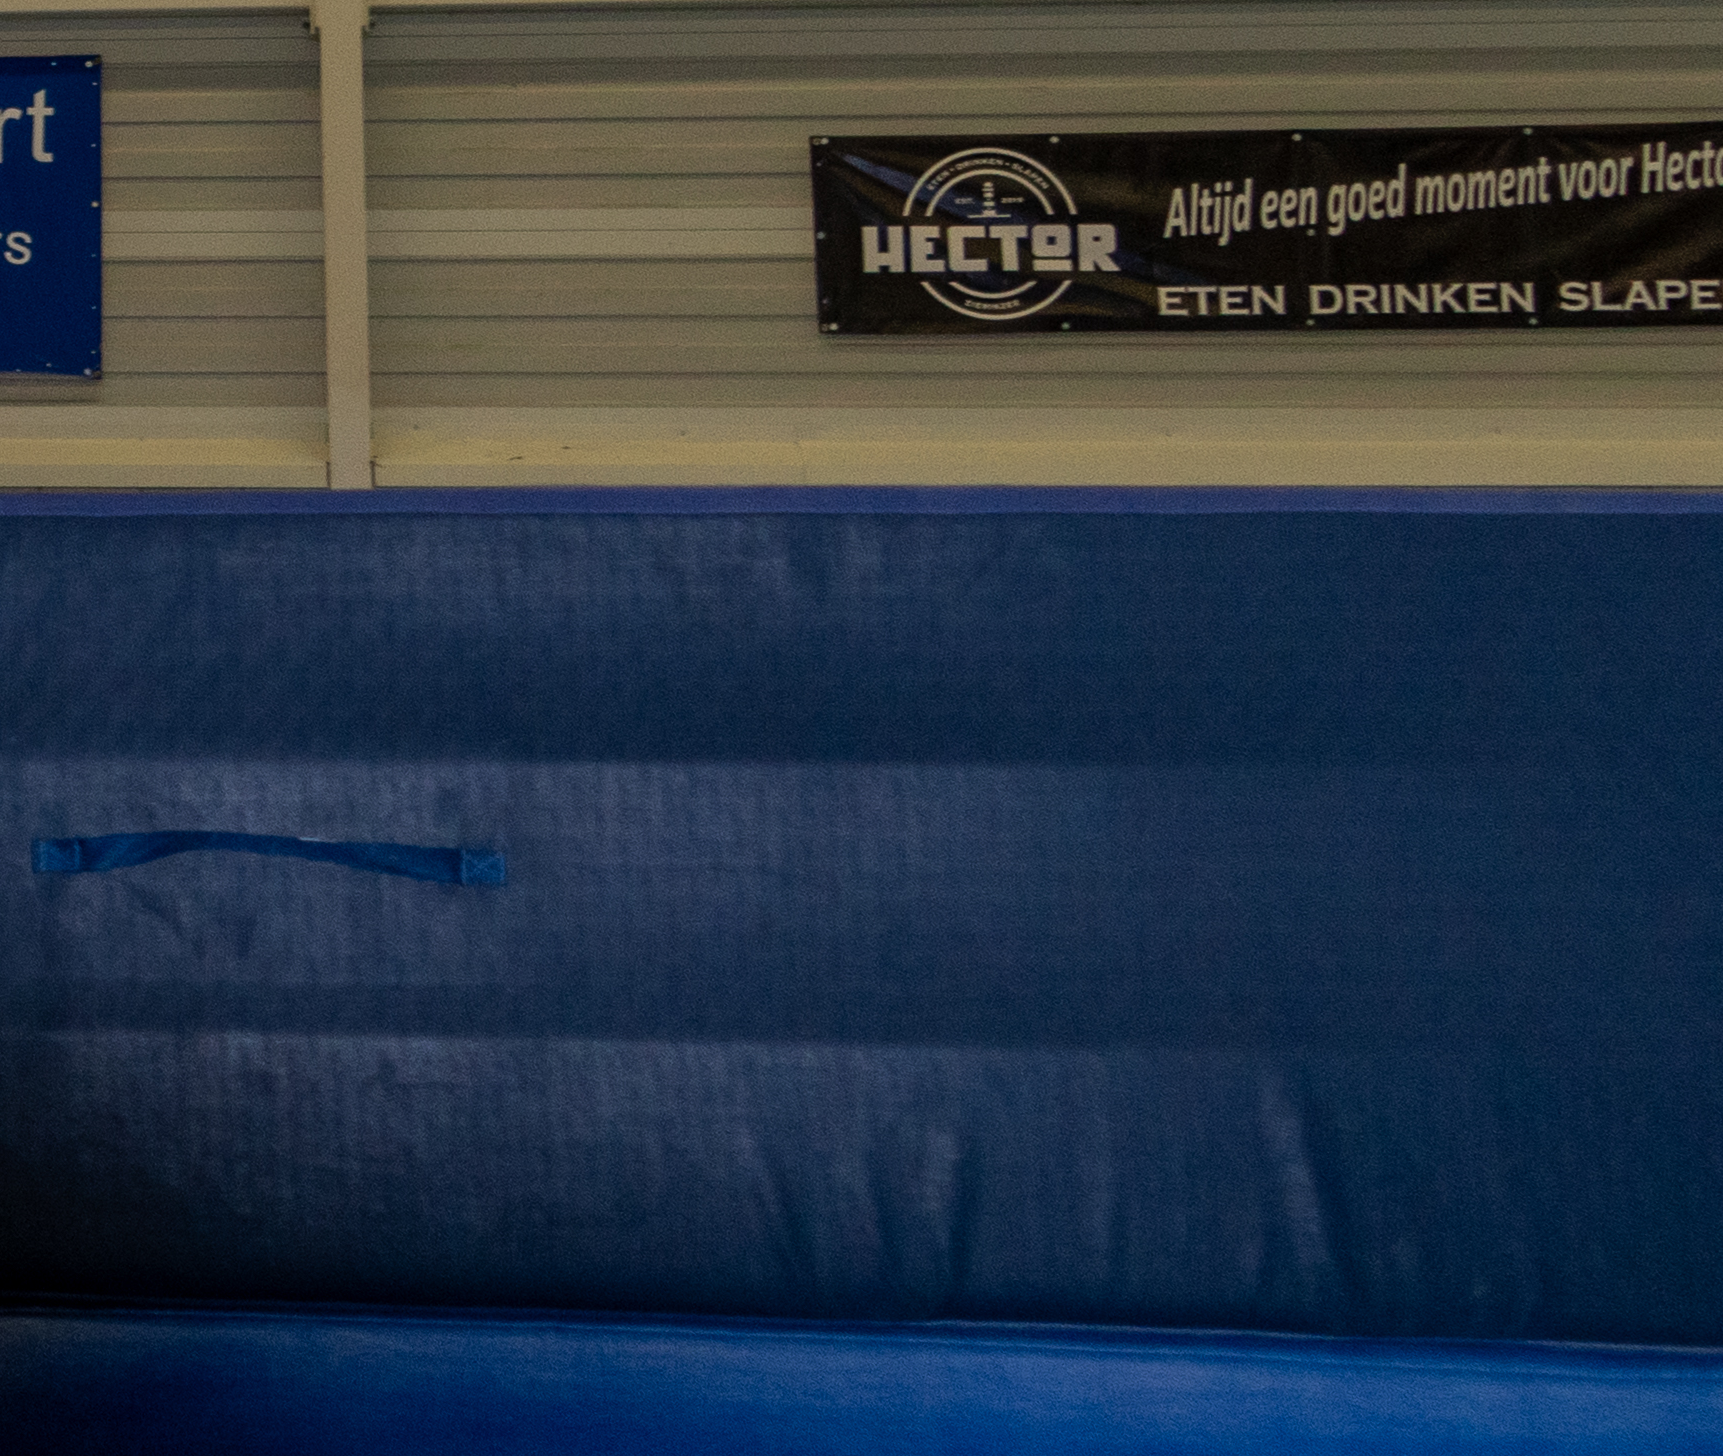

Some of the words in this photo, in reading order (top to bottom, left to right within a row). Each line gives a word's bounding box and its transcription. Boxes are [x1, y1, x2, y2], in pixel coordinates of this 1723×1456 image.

[1163, 178, 1254, 247] Altijd
[1259, 186, 1318, 230] een
[1327, 162, 1406, 237] goed
[1414, 156, 1552, 215] moment
[1558, 156, 1634, 201] voor
[861, 223, 1122, 273] HECTOR
[1156, 284, 1287, 316] ETEN
[1309, 282, 1537, 315] DRINKEN
[1559, 279, 1723, 312] SLAPE
